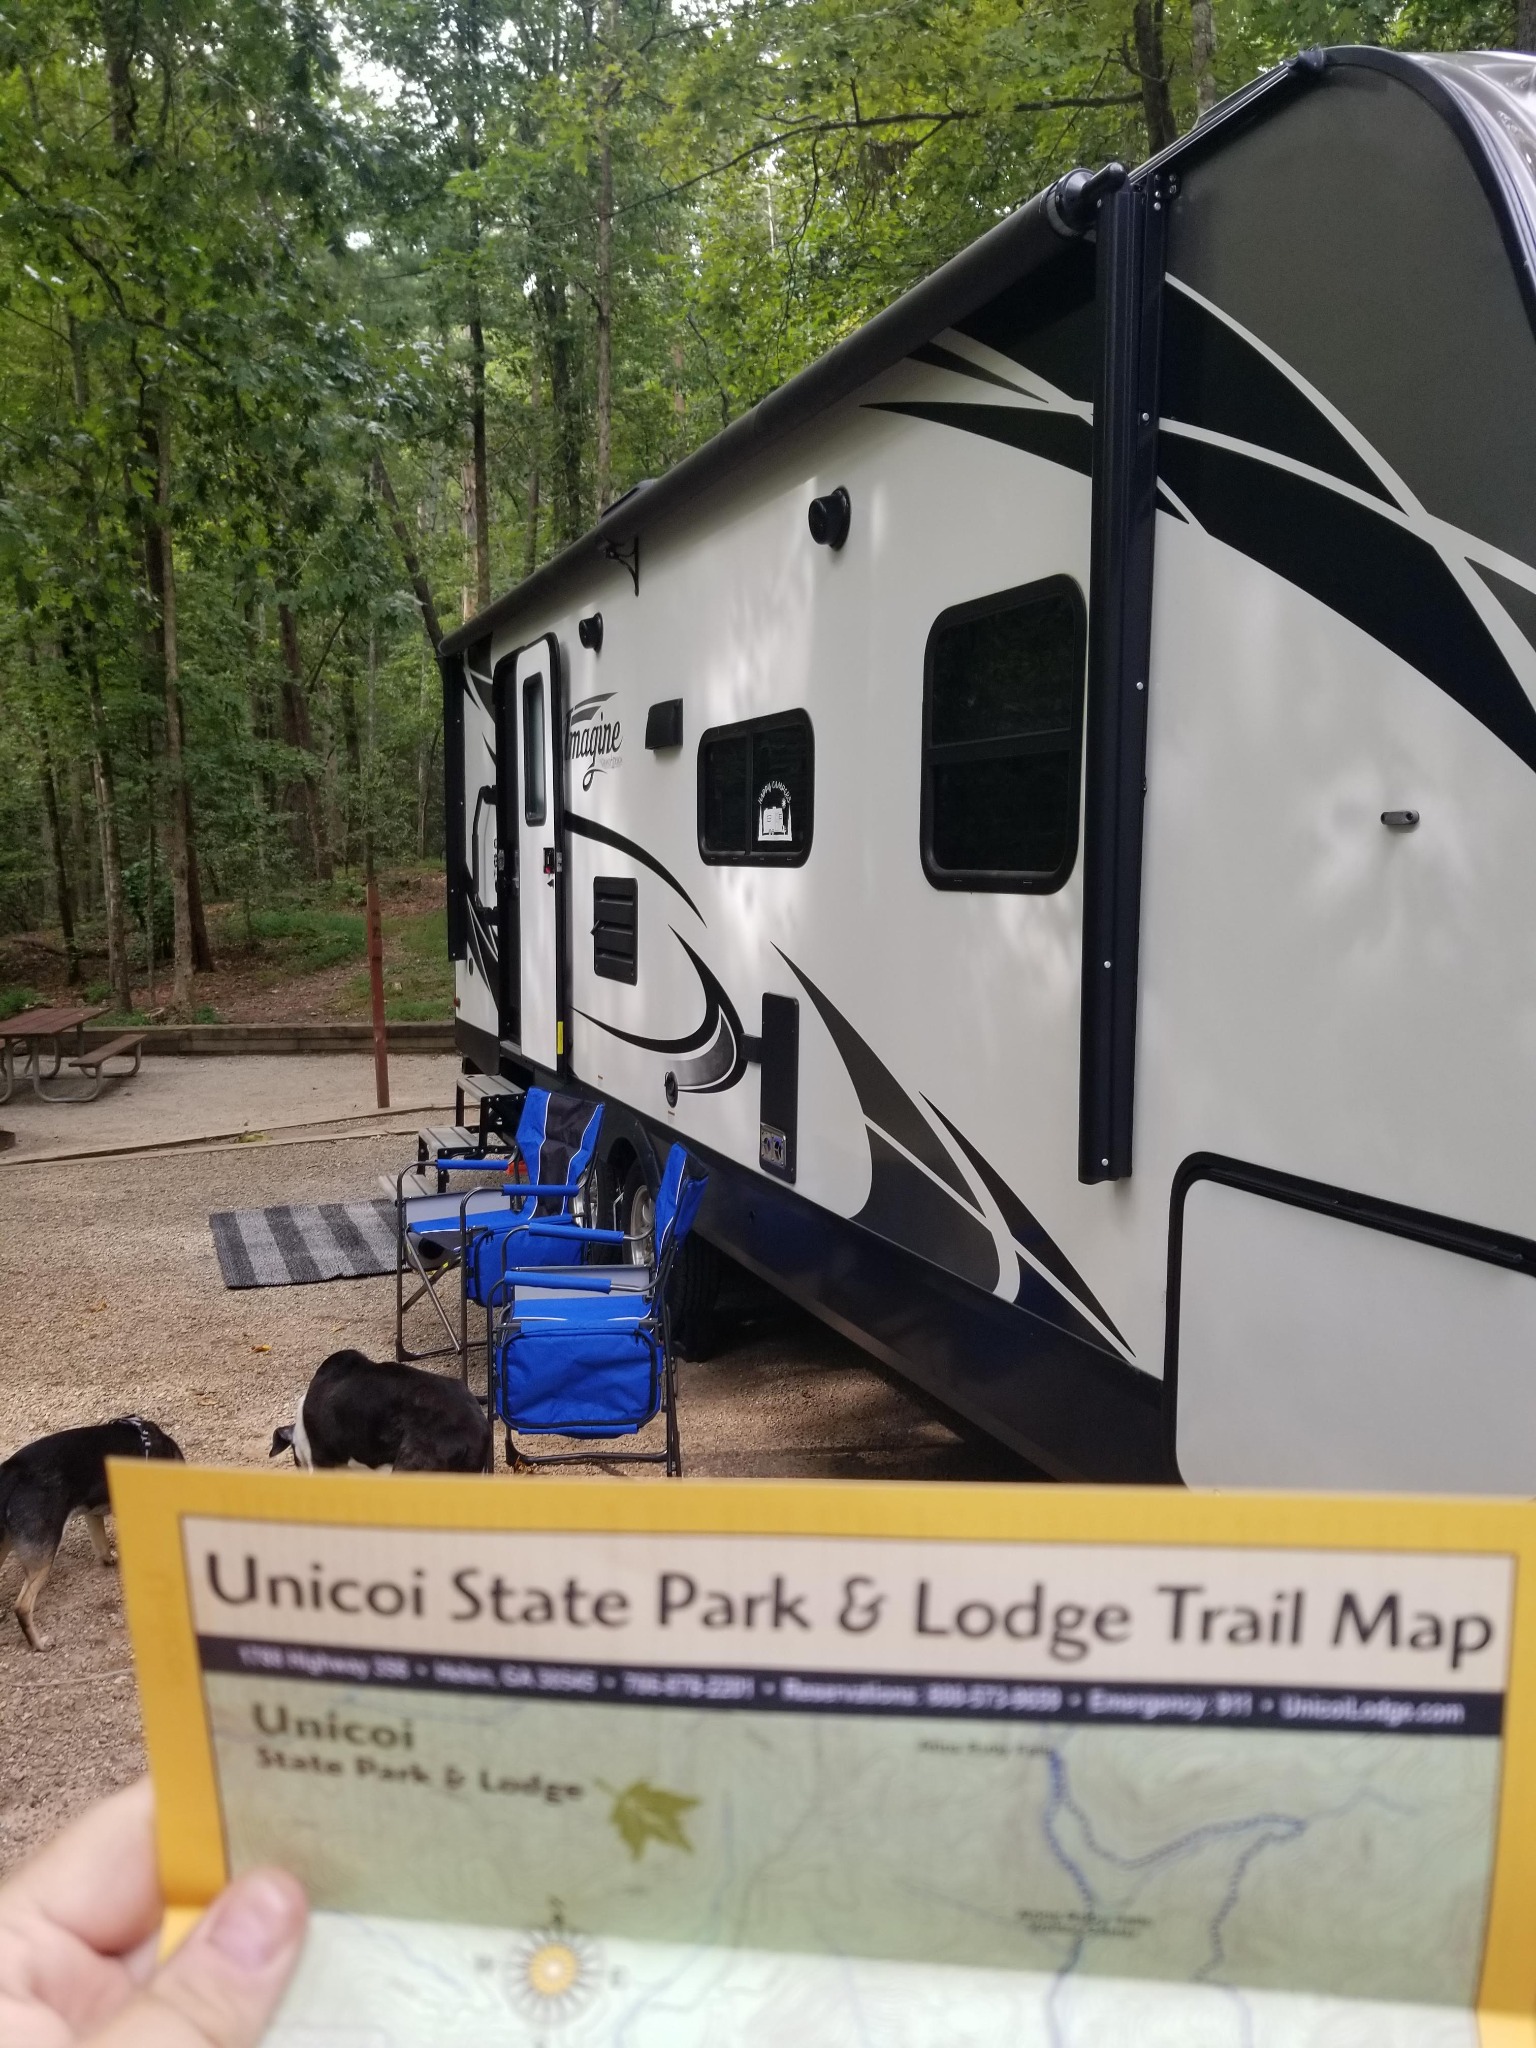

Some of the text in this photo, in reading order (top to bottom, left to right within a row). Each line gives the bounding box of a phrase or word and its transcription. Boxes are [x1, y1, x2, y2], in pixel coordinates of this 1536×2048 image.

[206, 1552, 1495, 1669] Unicoi State Park & Lodge Trail Map
[253, 1701, 415, 1750] Unicoi
[256, 1747, 586, 1806] State Park & Lodge
